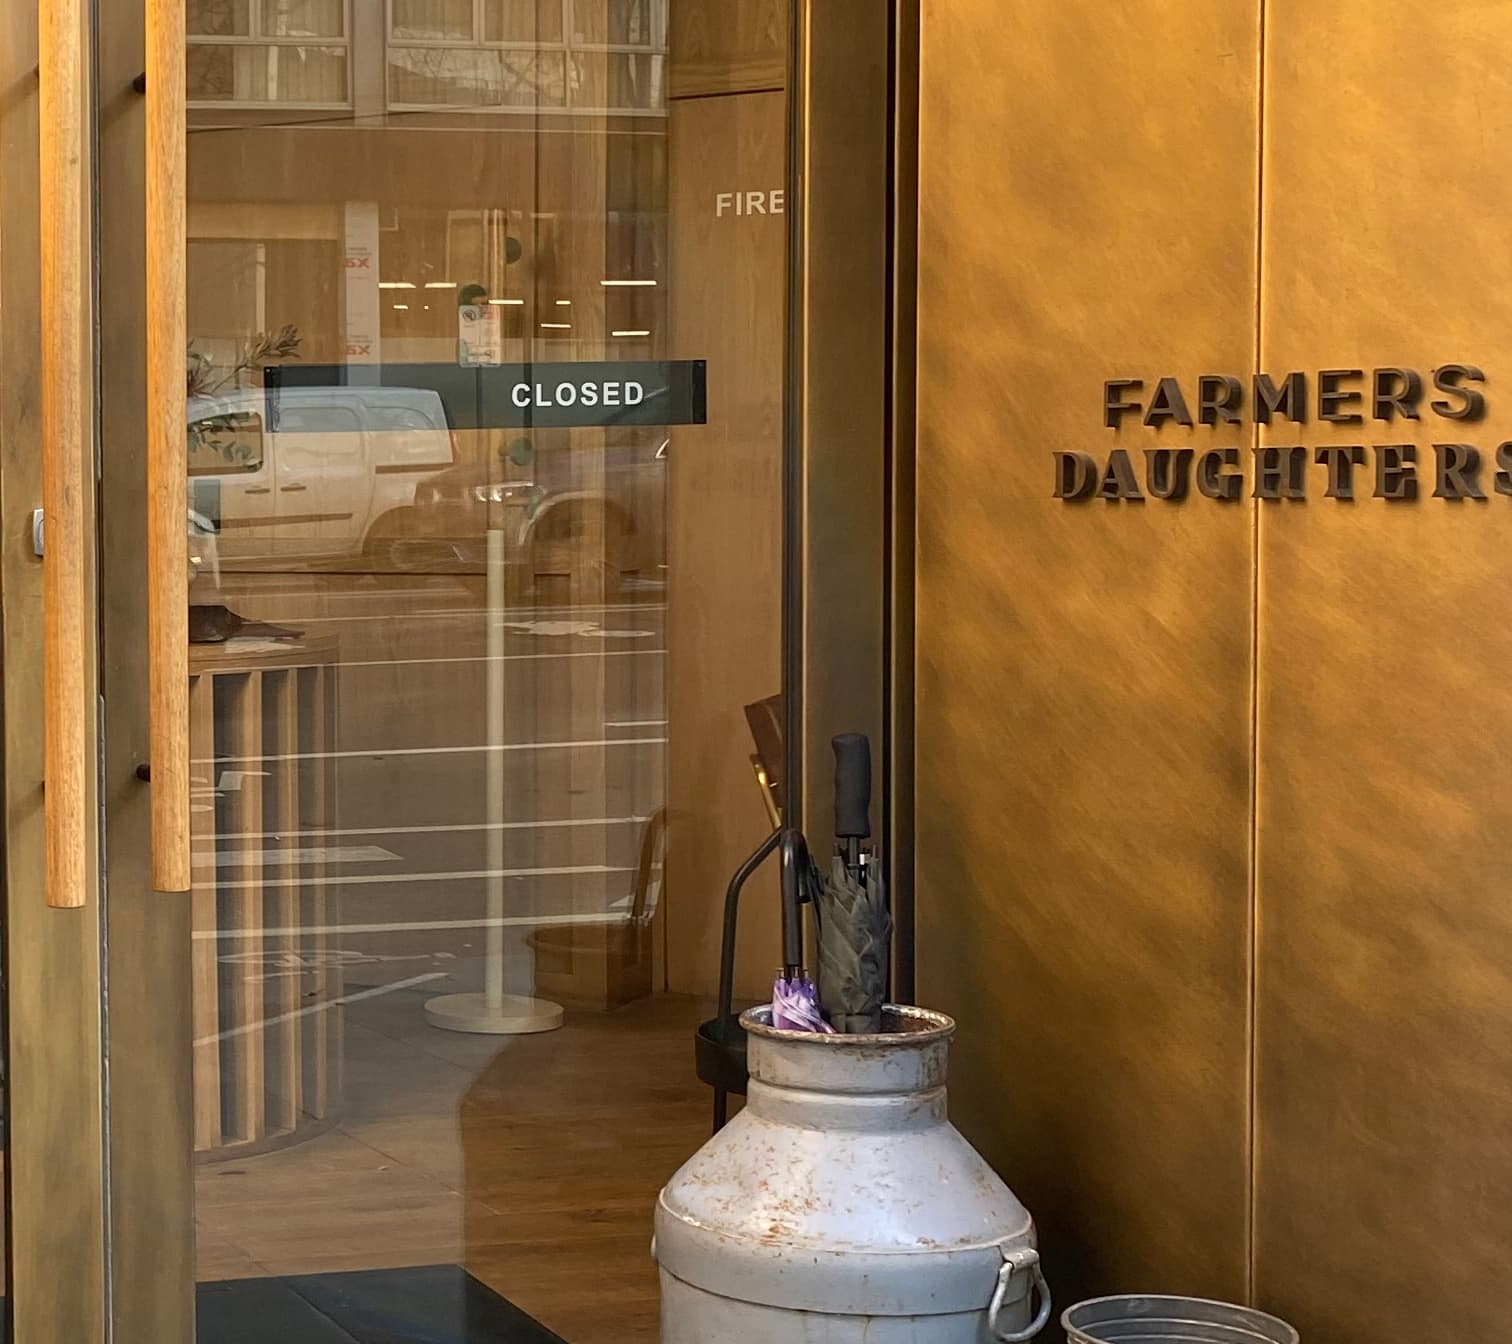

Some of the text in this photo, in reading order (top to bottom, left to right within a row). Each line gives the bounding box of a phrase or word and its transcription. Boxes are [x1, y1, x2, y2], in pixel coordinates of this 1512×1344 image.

[716, 189, 785, 217] FIRE
[511, 382, 644, 408] CLOSED
[1103, 364, 1486, 428] FARMERS
